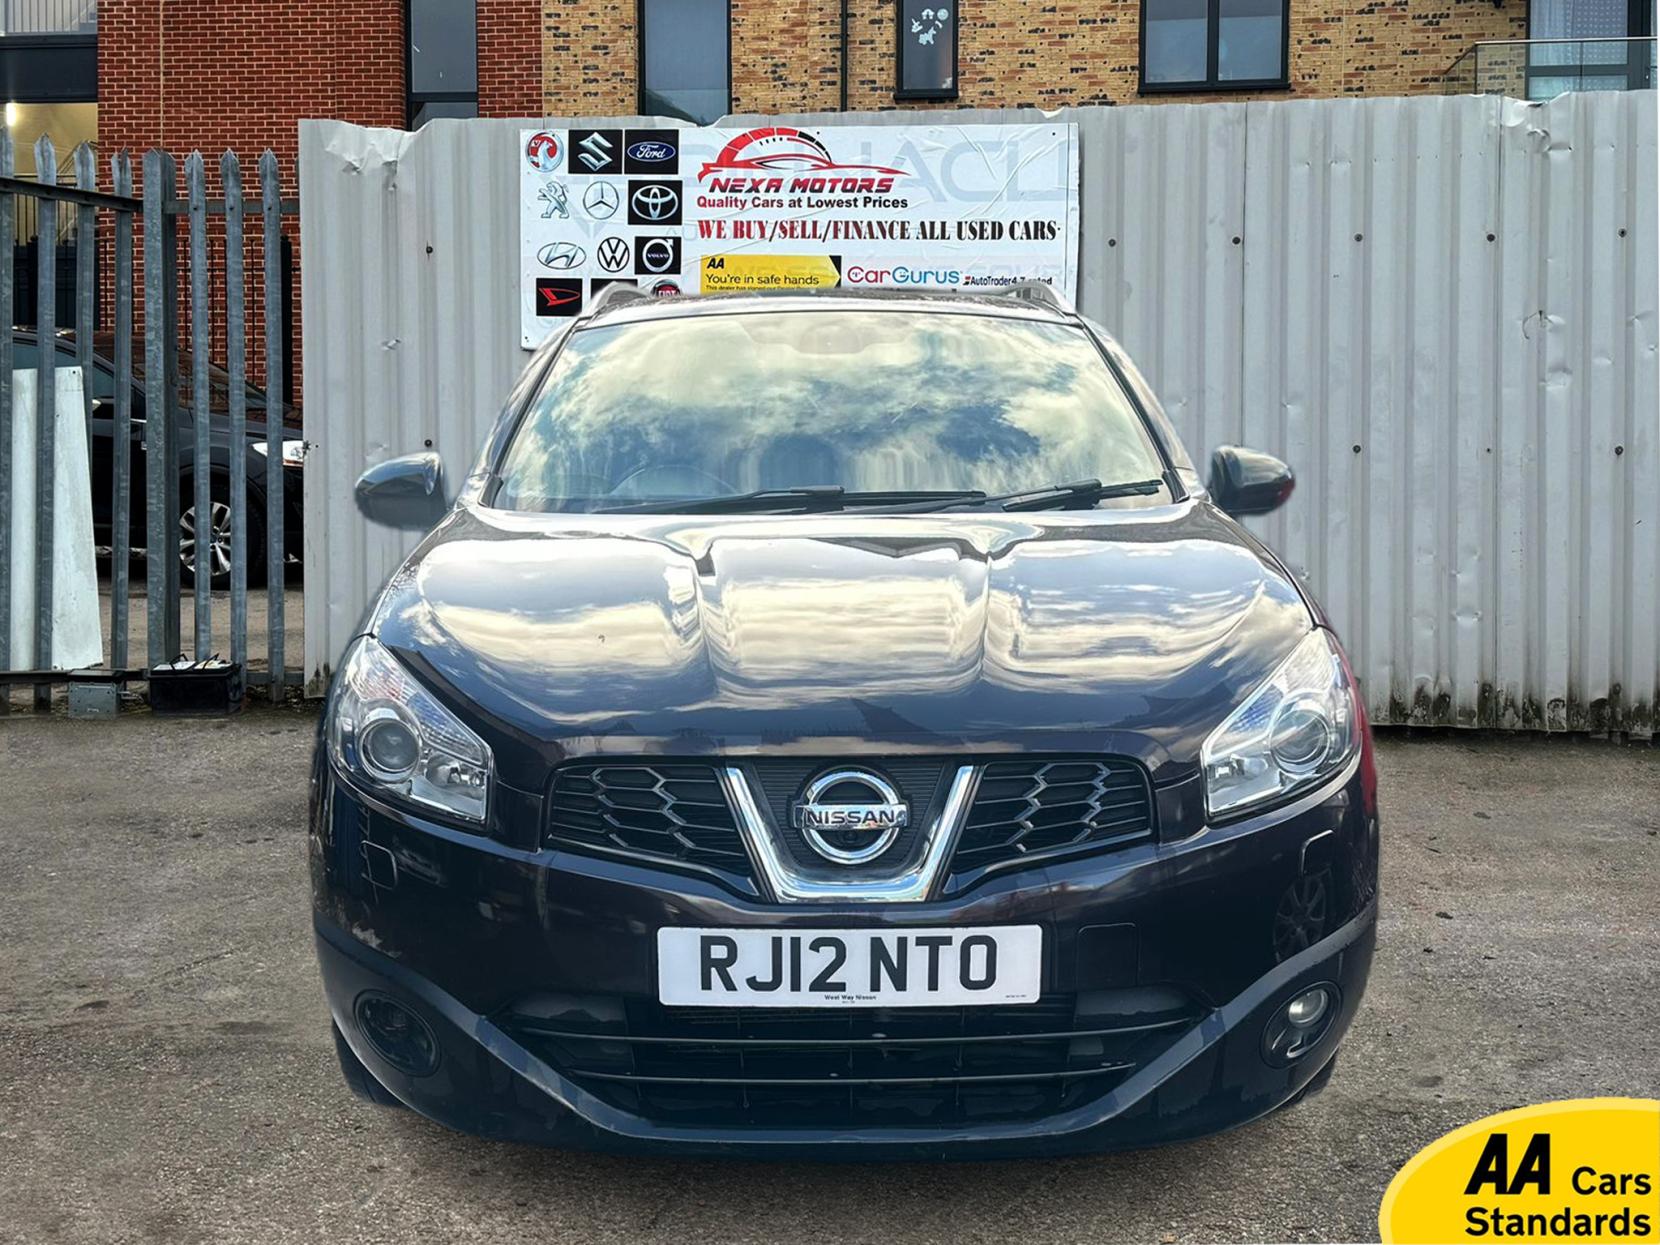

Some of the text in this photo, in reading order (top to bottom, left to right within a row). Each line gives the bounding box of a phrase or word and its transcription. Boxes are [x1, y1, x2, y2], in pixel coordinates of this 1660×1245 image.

[636, 144, 666, 159] Ford
[709, 178, 895, 193] NEXA MOTORS
[697, 196, 908, 210] Quality Cars at Lowest Prices
[697, 220, 726, 240] WE
[733, 219, 911, 243] BUY/SELL/FINANCE
[916, 220, 951, 241] ALL
[957, 220, 1004, 241] USED
[706, 258, 725, 269] AA
[706, 274, 820, 285] You're in safe hands
[847, 266, 960, 284] CarGurus
[971, 276, 1011, 286] AutoTrader
[806, 810, 895, 824] NISSAN
[700, 935, 997, 992] RJ12 NTO
